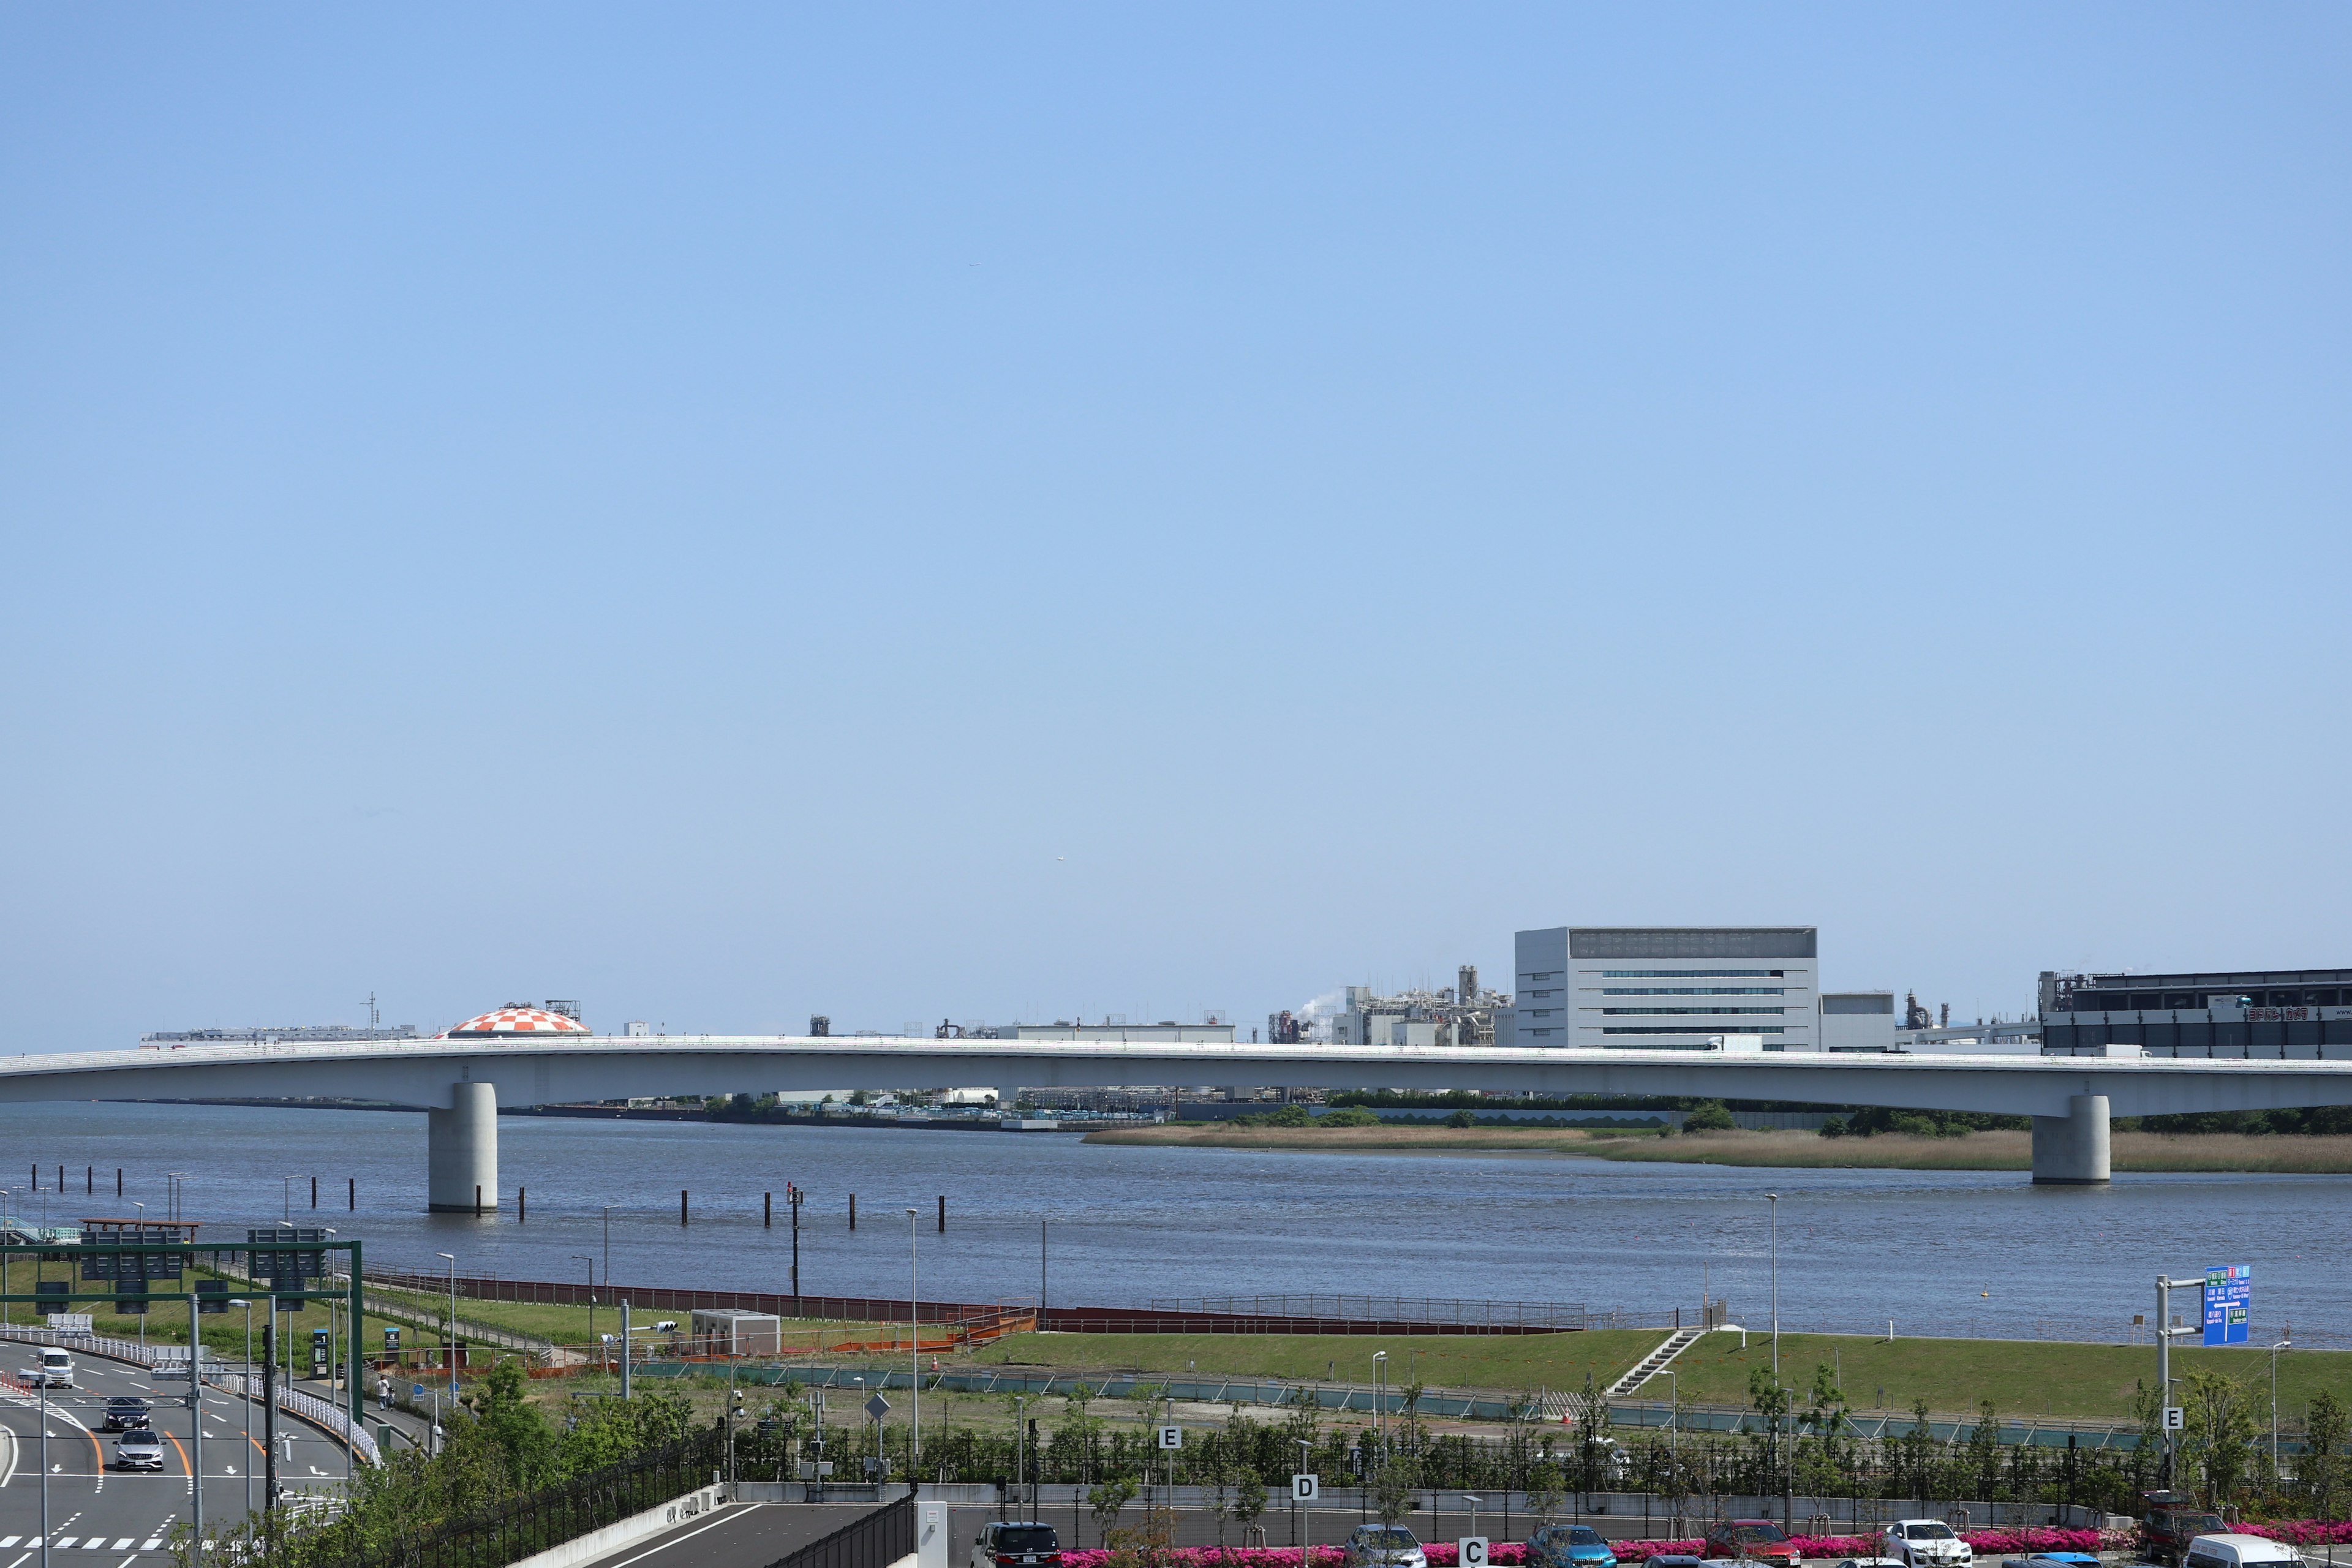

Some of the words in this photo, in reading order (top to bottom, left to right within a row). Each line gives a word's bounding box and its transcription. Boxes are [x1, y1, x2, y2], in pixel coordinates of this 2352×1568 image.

[2168, 1411, 2178, 1426] E
[1165, 1430, 1176, 1445] E
[1299, 1479, 1312, 1496] D
[1466, 1541, 1482, 1563] C
